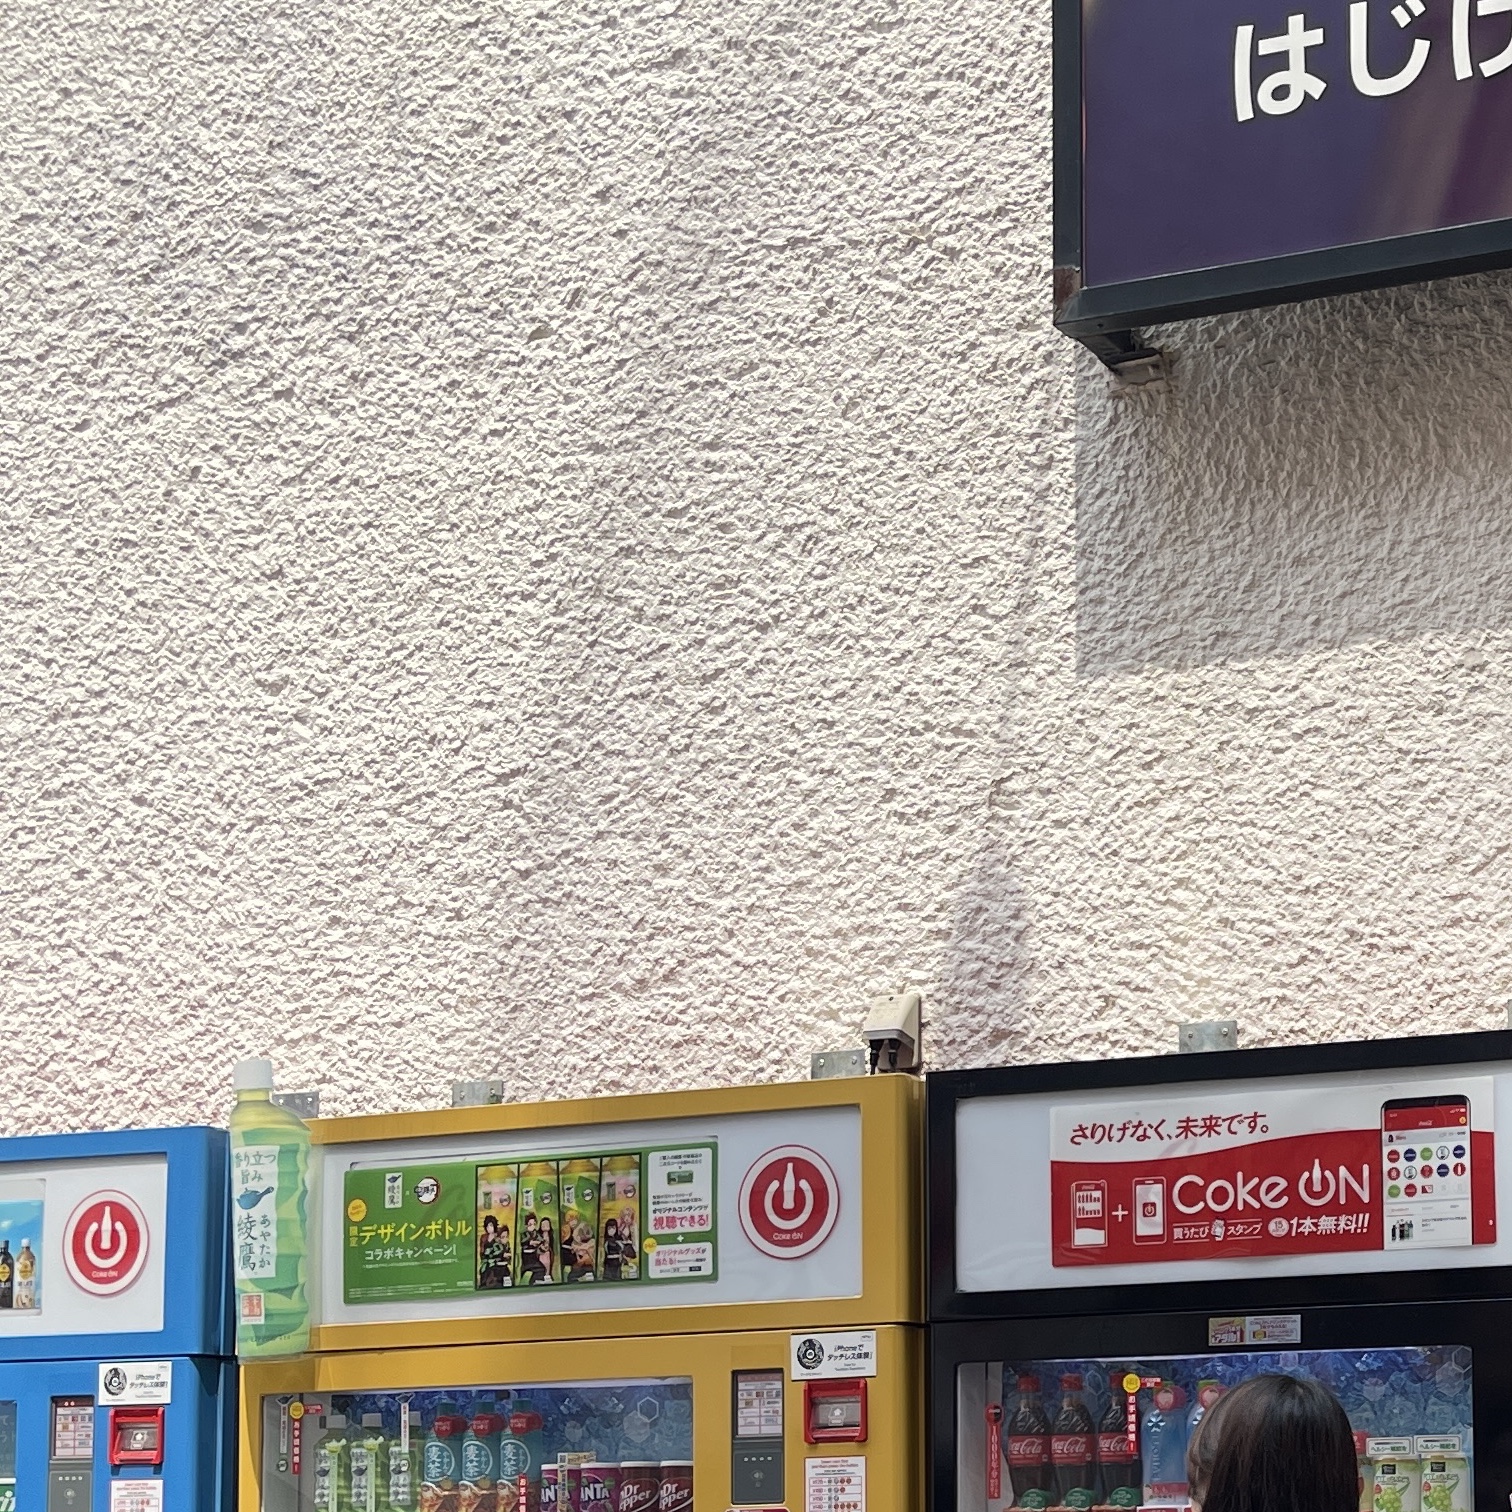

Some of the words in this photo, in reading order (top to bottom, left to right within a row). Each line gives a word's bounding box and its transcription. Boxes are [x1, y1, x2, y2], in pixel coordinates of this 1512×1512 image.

[1070, 1111, 1270, 1145] さりげなく、未来です。
[241, 1170, 263, 1185] 旨み
[1172, 1170, 1289, 1215] Coke
[1297, 1158, 1370, 1207] ON
[359, 1219, 472, 1245] デザインボトル
[653, 1214, 709, 1230] 視聴できる!
[1173, 1226, 1210, 1240] 買うたび
[1227, 1223, 1262, 1236] スタンプ
[1289, 1213, 1370, 1237] 1本無料!!
[238, 1212, 257, 1271] 綾鷹
[258, 1214, 272, 1269] あやたか
[365, 1243, 457, 1261] コラボキャンペーン!
[827, 1351, 873, 1362] タッチレス体験!
[834, 1344, 864, 1352] iPhoneで
[427, 1446, 441, 1477] 麦茶
[465, 1444, 480, 1476] 麦茶
[503, 1444, 517, 1475] 麦茶
